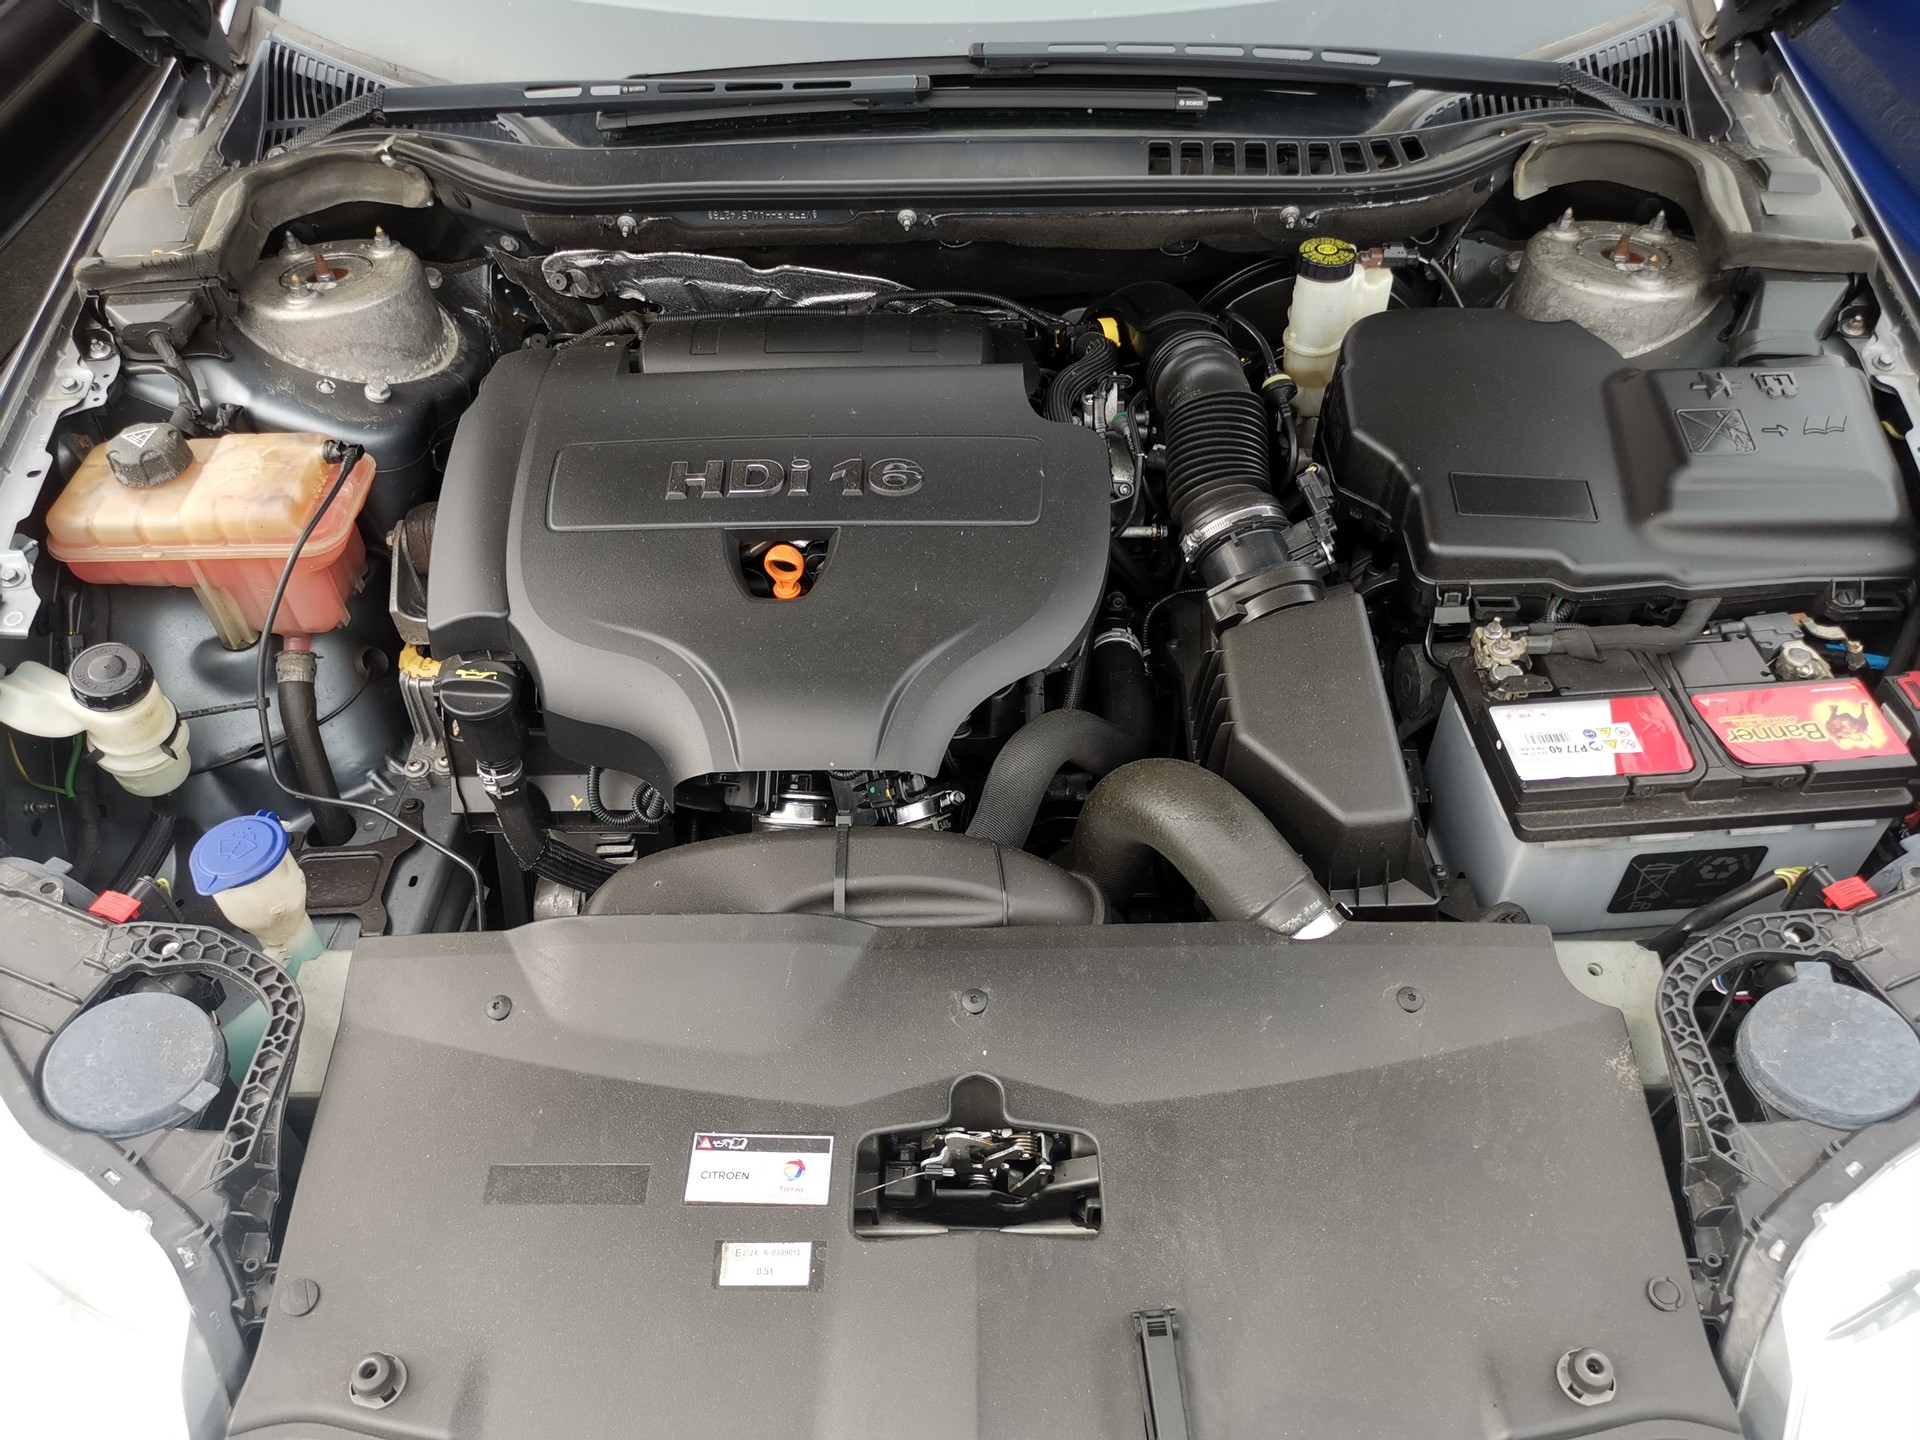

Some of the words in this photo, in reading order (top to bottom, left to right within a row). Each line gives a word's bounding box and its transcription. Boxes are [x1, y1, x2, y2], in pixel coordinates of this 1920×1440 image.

[665, 458, 811, 500] HDi
[829, 457, 925, 498] 16
[95, 647, 120, 655] LYON
[1729, 722, 1826, 742] Banner
[1548, 745, 1563, 754] 40
[1566, 744, 1588, 753] P77
[1628, 901, 1652, 911] Pb
[778, 1185, 806, 1193] TOTAL
[756, 1267, 774, 1276] 0.51
